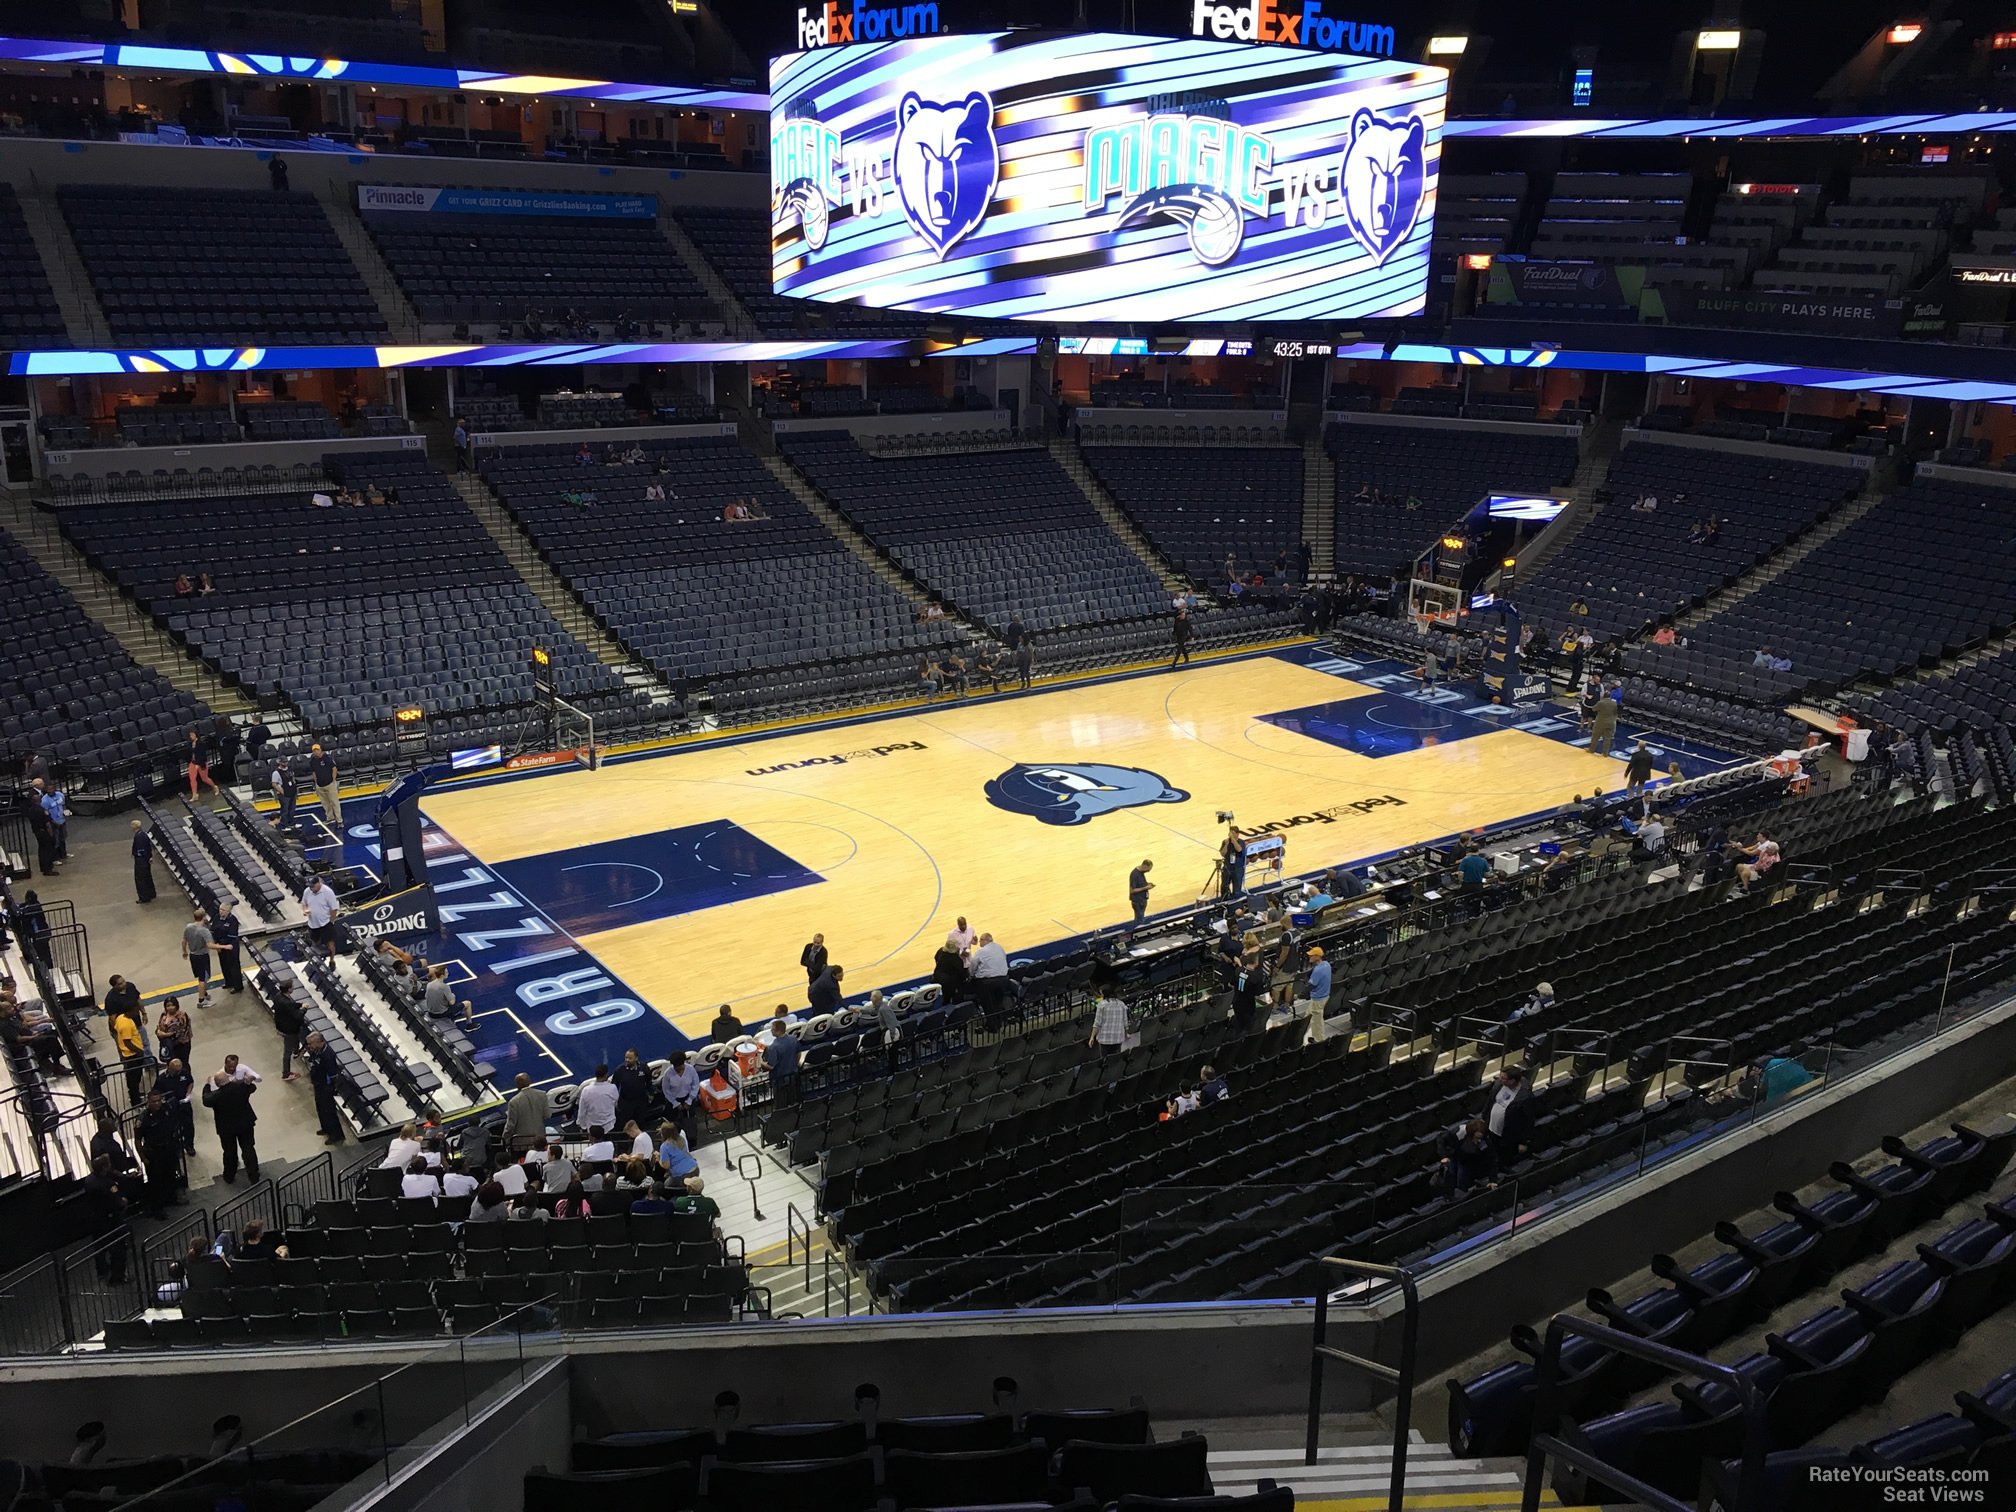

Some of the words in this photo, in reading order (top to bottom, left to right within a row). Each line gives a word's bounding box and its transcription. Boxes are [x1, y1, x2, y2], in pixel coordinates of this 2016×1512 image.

[797, 0, 938, 49] FedExForum
[1192, 0, 1395, 56] FedExForum
[771, 119, 841, 206] MAGIC
[1085, 115, 1273, 217] MAGIC
[1283, 165, 1328, 228] VS
[366, 188, 425, 205] Pinnacle
[479, 197, 500, 207] GRIZZ
[502, 198, 522, 208] CARD
[533, 199, 607, 211] GrizzliesBanking.com
[1523, 266, 1582, 281] FanDuel
[1962, 271, 2003, 282] FanDuel
[1697, 299, 1740, 311] BLUFF
[1745, 301, 1777, 313] CITY
[1782, 303, 1827, 317] PLAYS
[1832, 306, 1876, 320] HERE.
[1273, 342, 1302, 357] 43:25
[407, 439, 418, 447] 115
[53, 455, 67, 463] 115
[1513, 681, 1546, 700] SPALDING
[745, 740, 929, 777] FedExForum
[1238, 795, 1408, 837] FedExForum
[347, 911, 427, 945] PALDING
[898, 996, 911, 1009] G
[924, 989, 937, 1001] G
[814, 1019, 828, 1033] G
[840, 1012, 853, 1026] G
[705, 1048, 721, 1063] G
[554, 1090, 571, 1104] G
